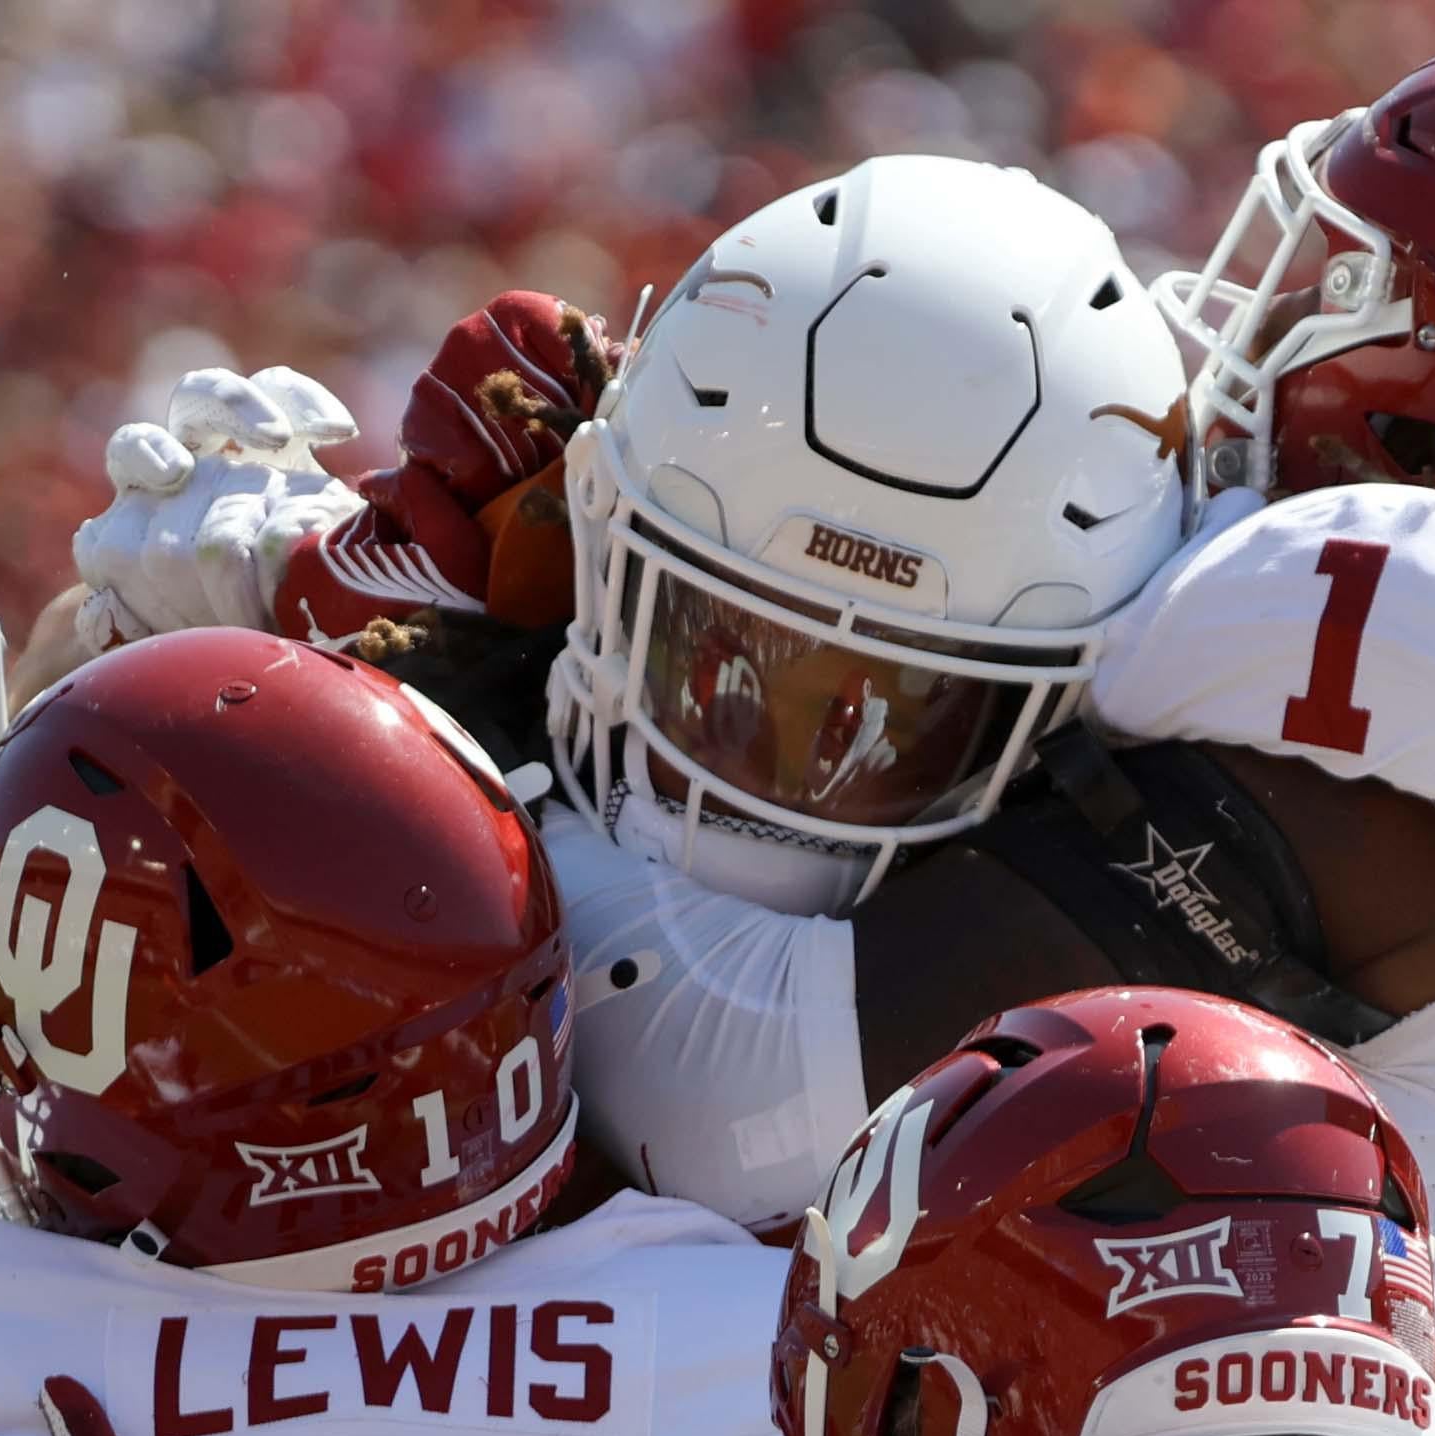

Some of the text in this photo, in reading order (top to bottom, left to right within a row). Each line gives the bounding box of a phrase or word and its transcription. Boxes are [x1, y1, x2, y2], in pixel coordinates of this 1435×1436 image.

[804, 523, 923, 588] HORNS
[1281, 538, 1391, 756] 1
[413, 1035, 543, 1190] 10
[1316, 1208, 1377, 1323] 7
[1173, 1350, 1435, 1430] SOONERS
